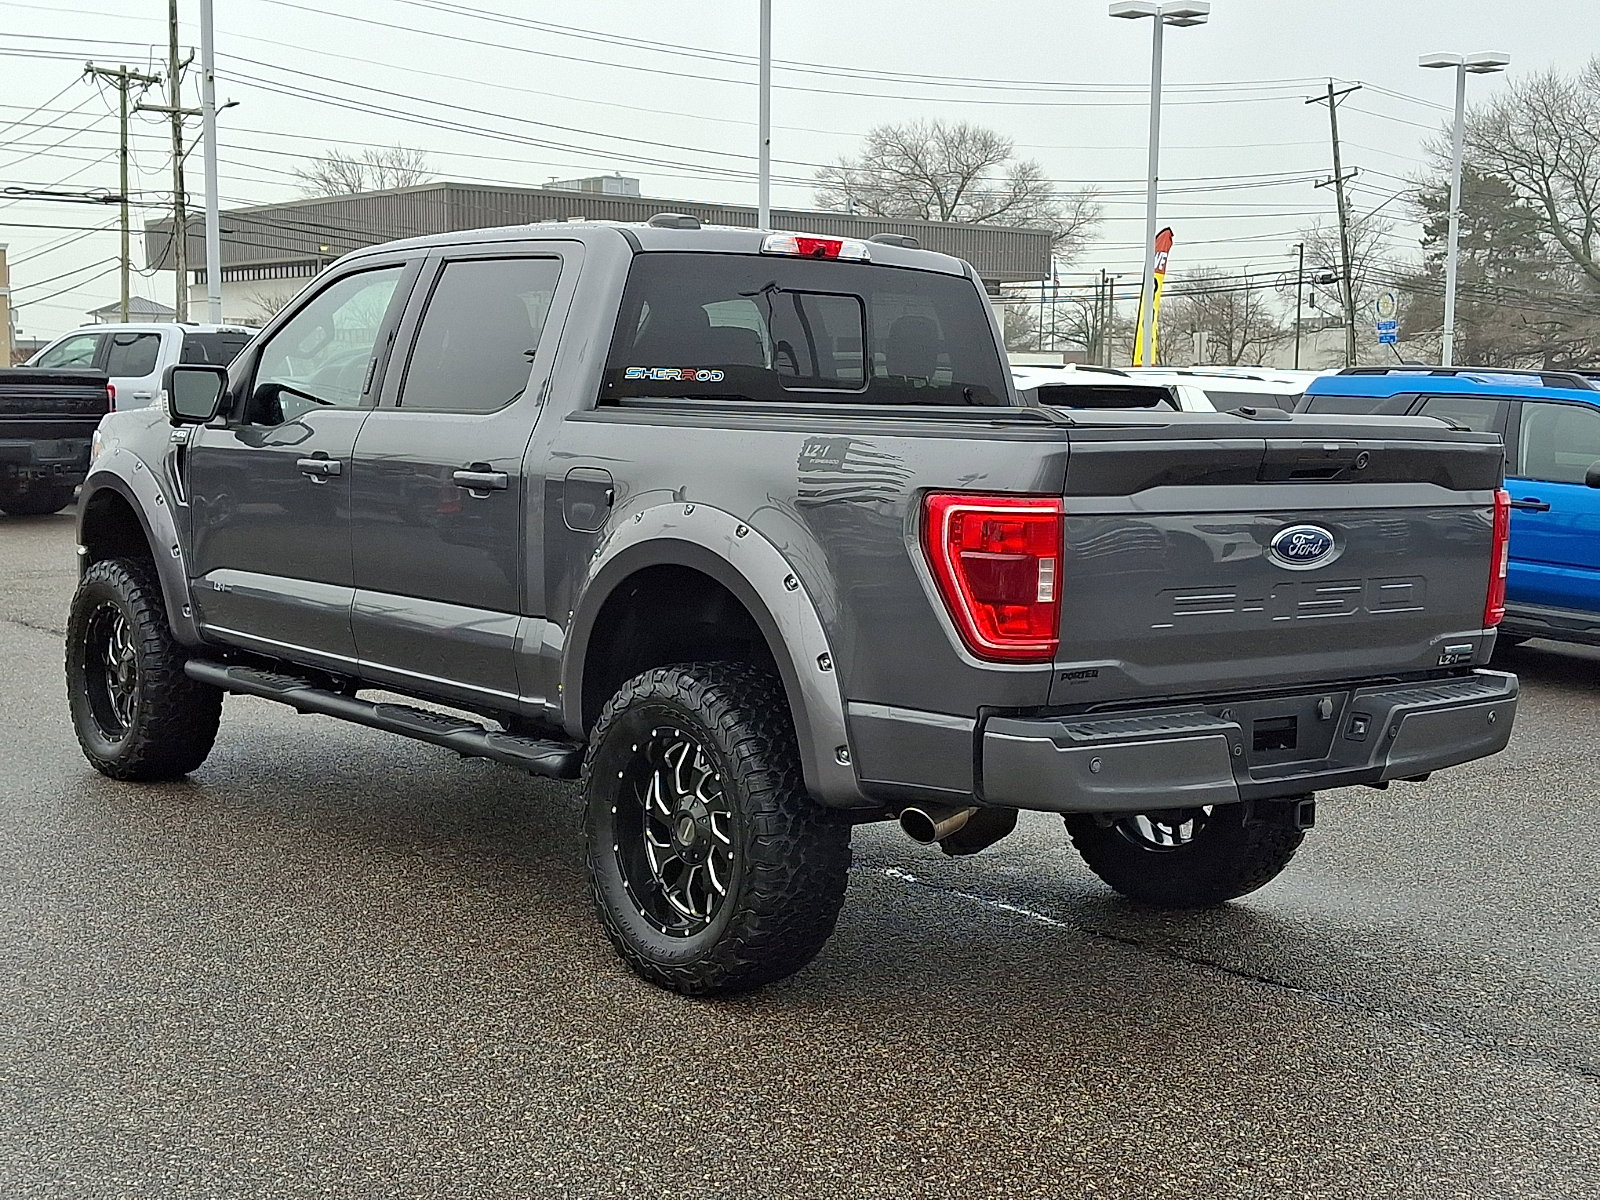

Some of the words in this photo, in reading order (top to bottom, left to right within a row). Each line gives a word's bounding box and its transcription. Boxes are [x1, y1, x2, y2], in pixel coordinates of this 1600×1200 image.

[624, 366, 725, 382] SHERROD
[1288, 533, 1323, 556] Ford
[1152, 576, 1427, 628] F-150
[1060, 669, 1099, 681] PORTER
